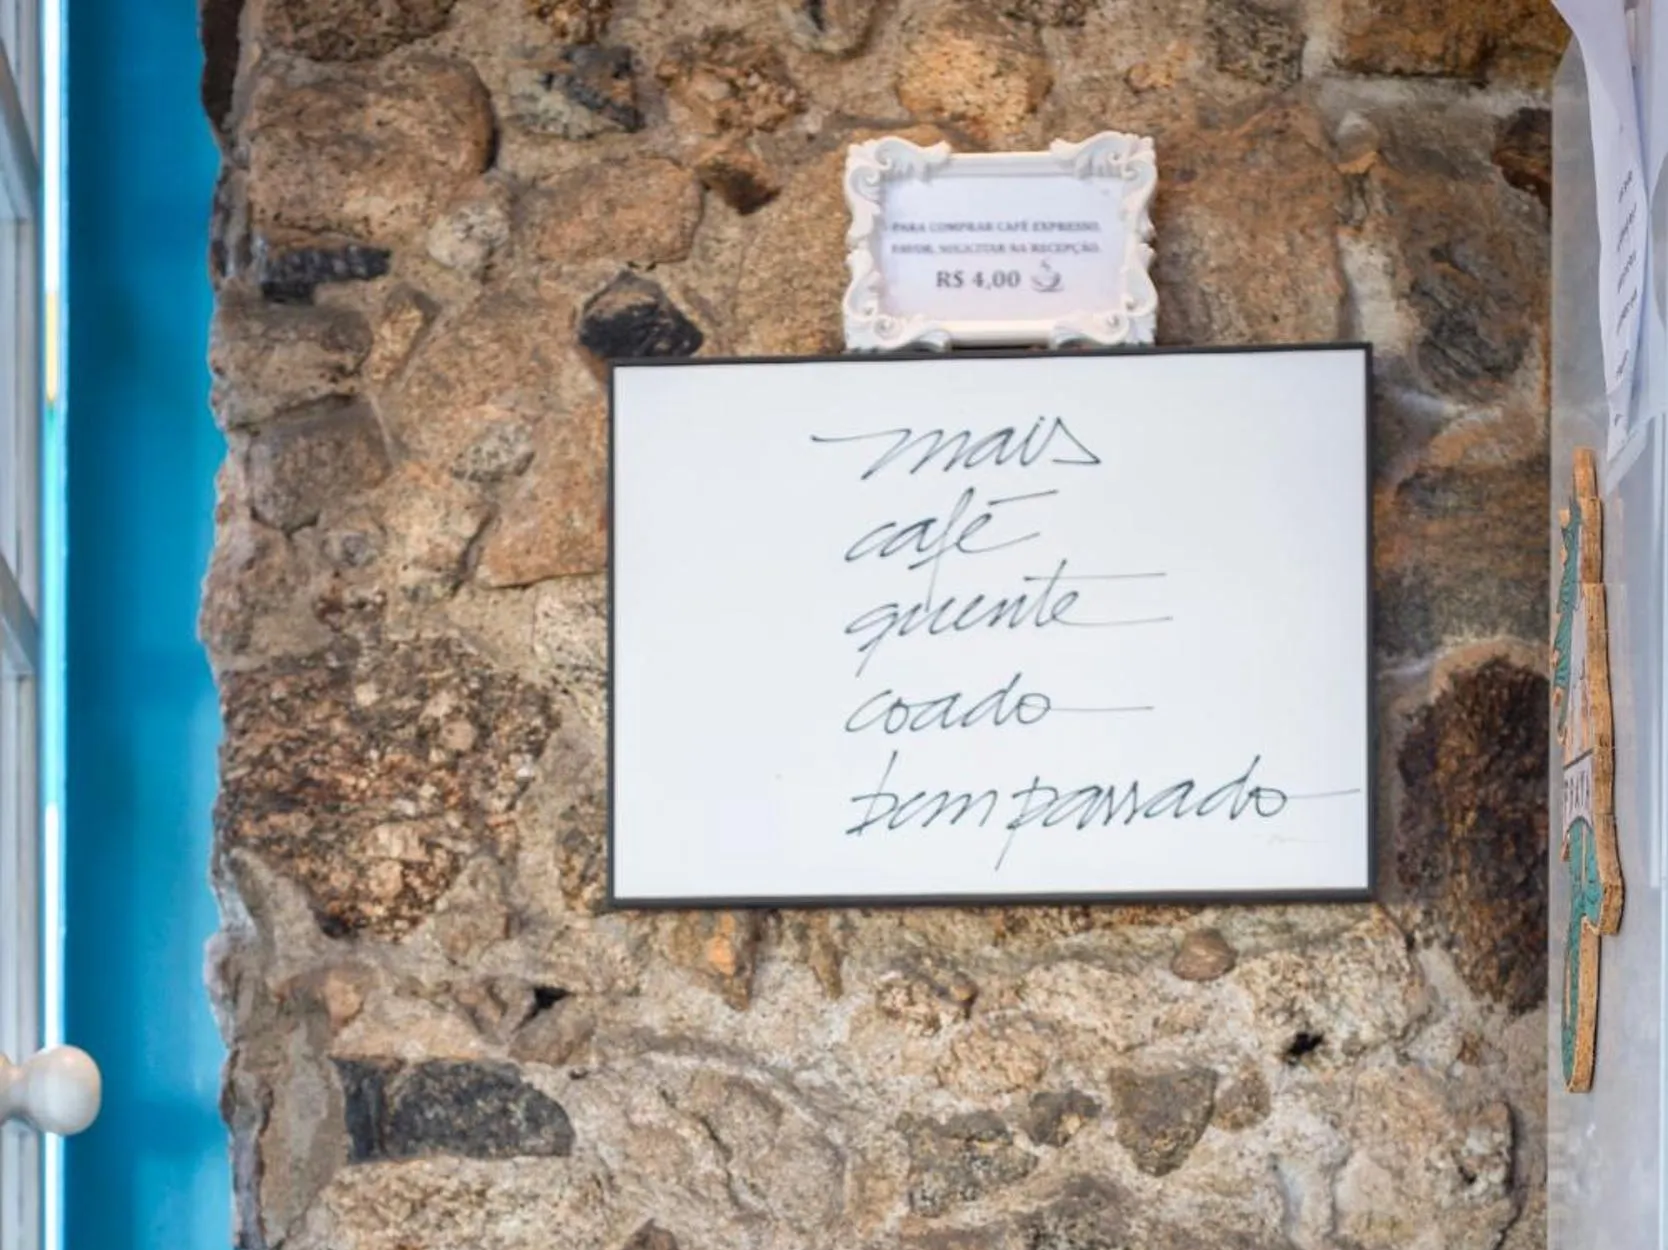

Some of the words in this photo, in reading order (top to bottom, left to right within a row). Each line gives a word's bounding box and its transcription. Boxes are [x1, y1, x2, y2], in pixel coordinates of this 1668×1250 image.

[891, 220, 925, 233] PARA
[928, 220, 994, 233] COMPRAR
[997, 217, 1028, 233] CAFÉ
[936, 270, 963, 289] R$
[972, 270, 1022, 291] 4,00
[810, 416, 1102, 480] mais
[844, 486, 1059, 611] café
[844, 558, 1173, 678] quente
[844, 672, 1154, 734] coado
[994, 754, 1361, 871] passado
